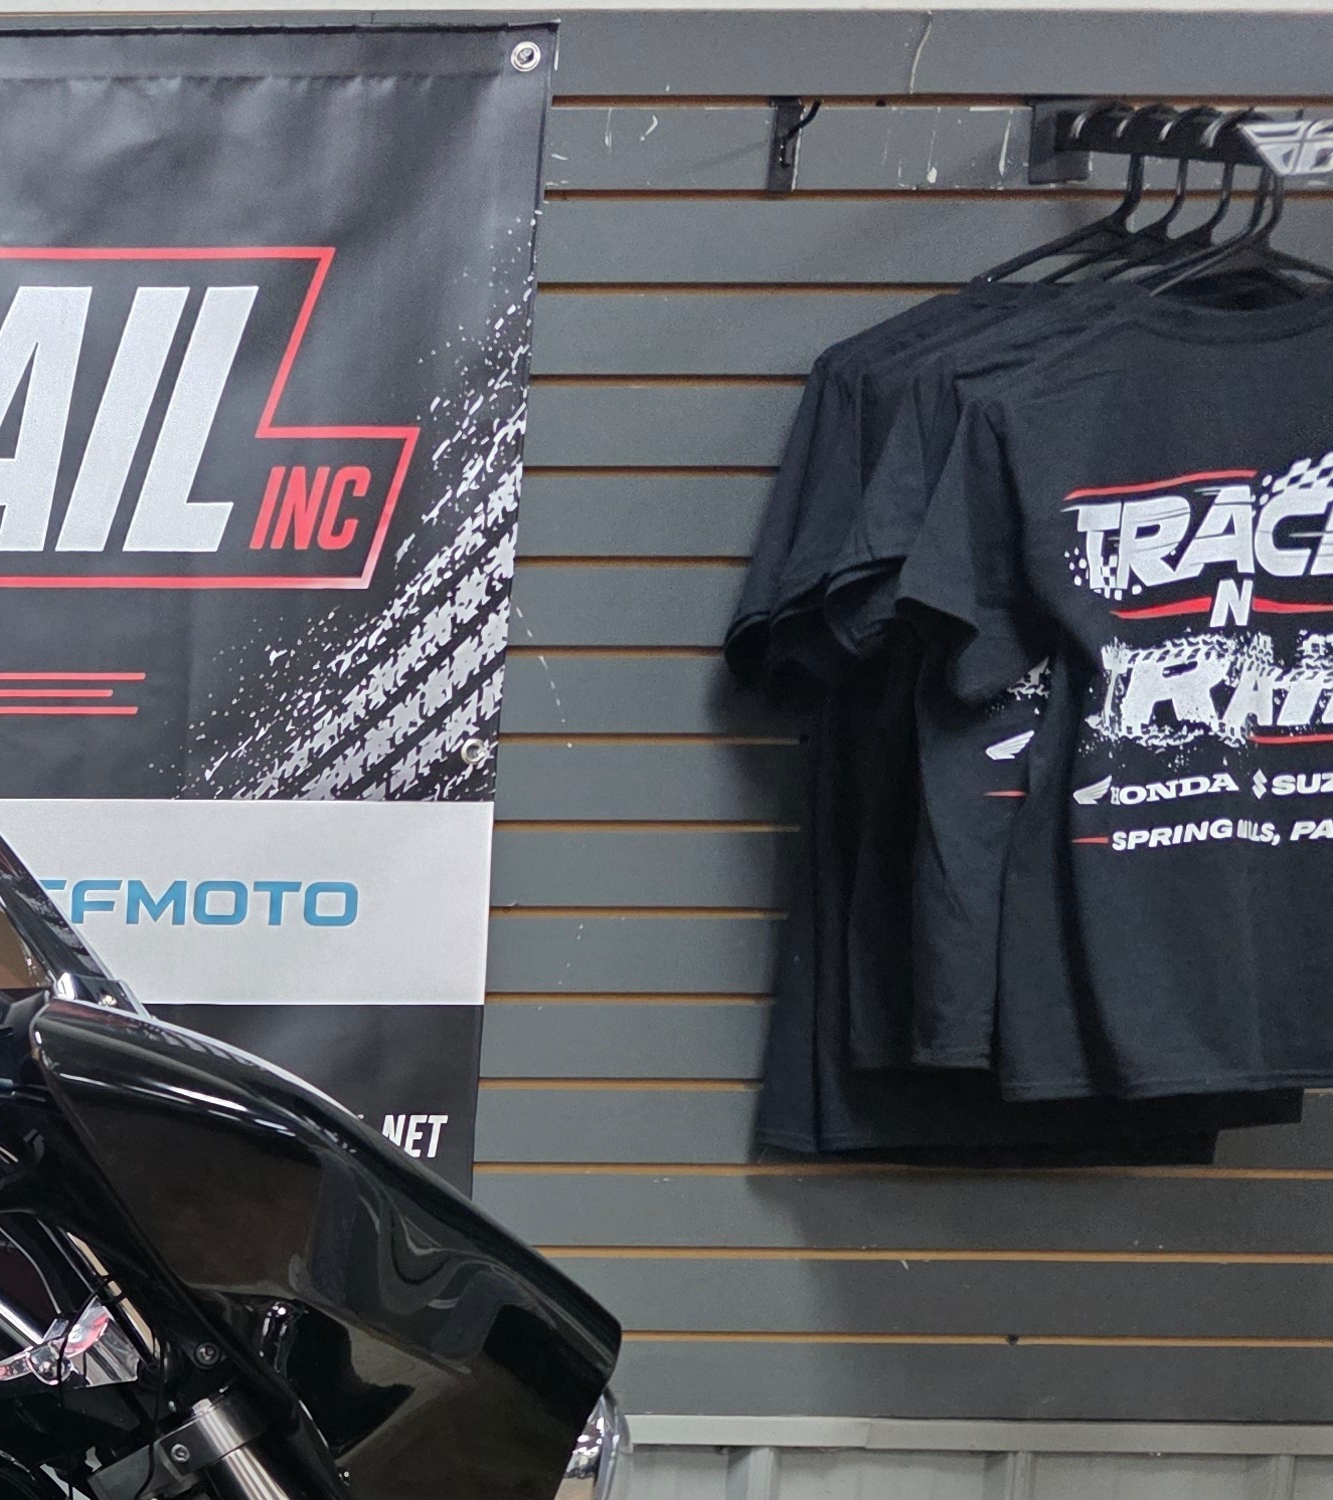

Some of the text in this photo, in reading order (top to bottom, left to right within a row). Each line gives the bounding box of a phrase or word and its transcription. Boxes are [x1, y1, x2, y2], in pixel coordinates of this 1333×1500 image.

[249, 465, 370, 551] INC
[1209, 578, 1254, 628] N
[1110, 773, 1240, 805] HONDA
[1111, 818, 1233, 851] SPRING
[40, 879, 358, 927] FMOTO
